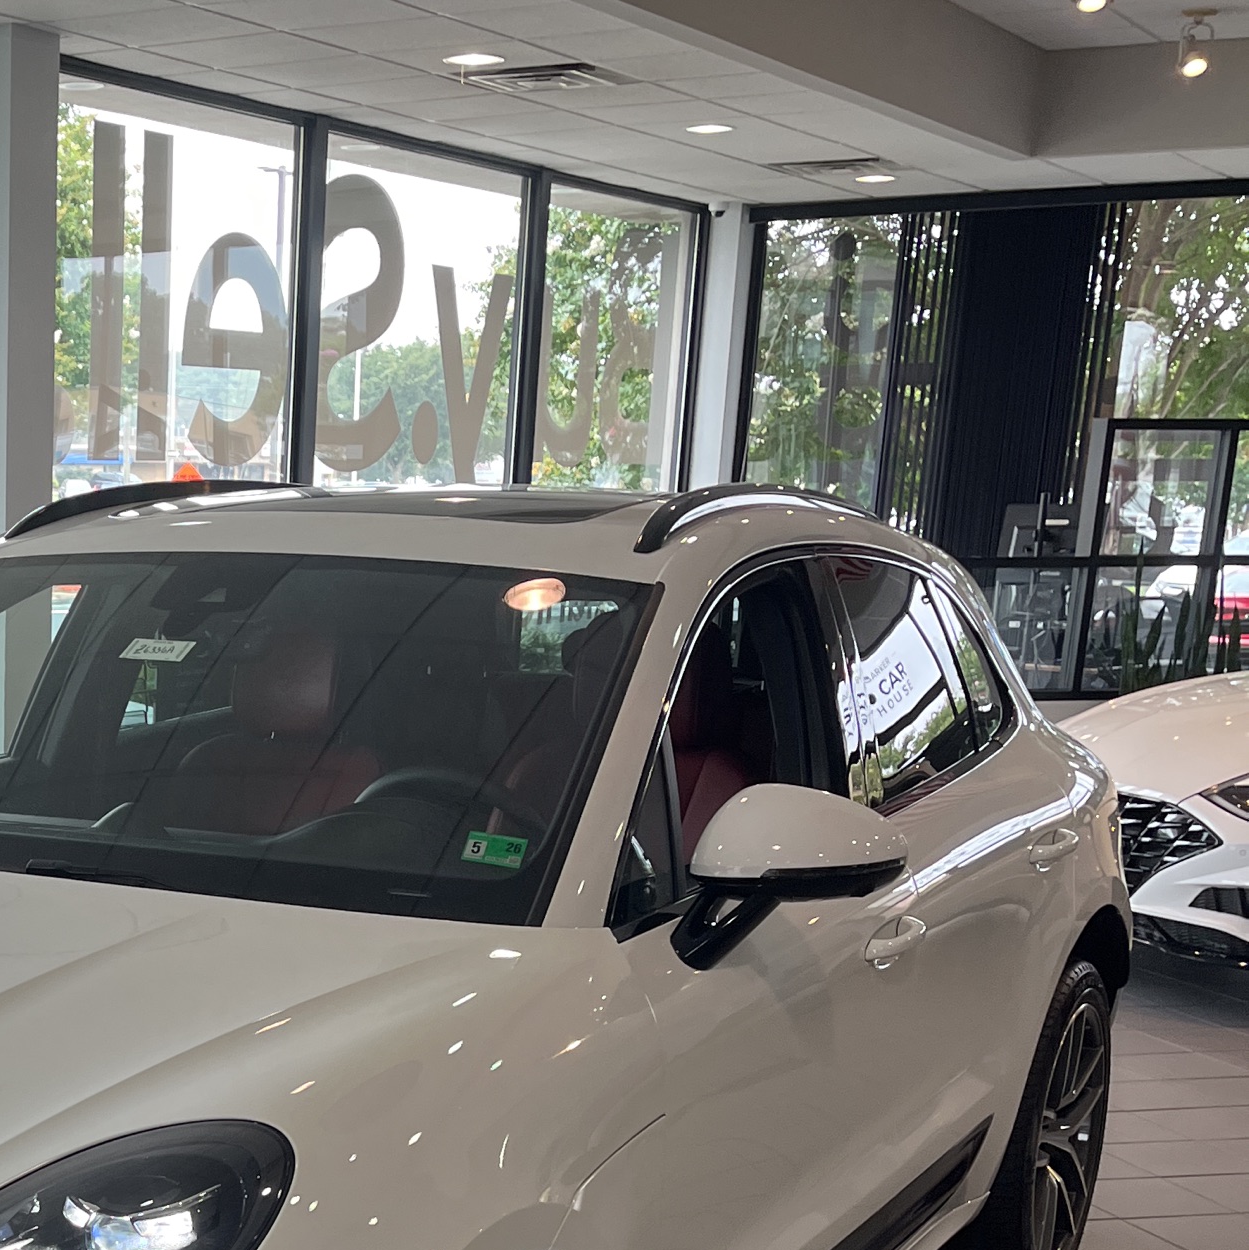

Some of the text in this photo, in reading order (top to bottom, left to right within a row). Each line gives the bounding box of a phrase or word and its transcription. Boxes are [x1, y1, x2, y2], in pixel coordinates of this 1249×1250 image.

[879, 662, 907, 695] CAR
[877, 679, 914, 717] HOUSE
[471, 841, 522, 854] 5 26
